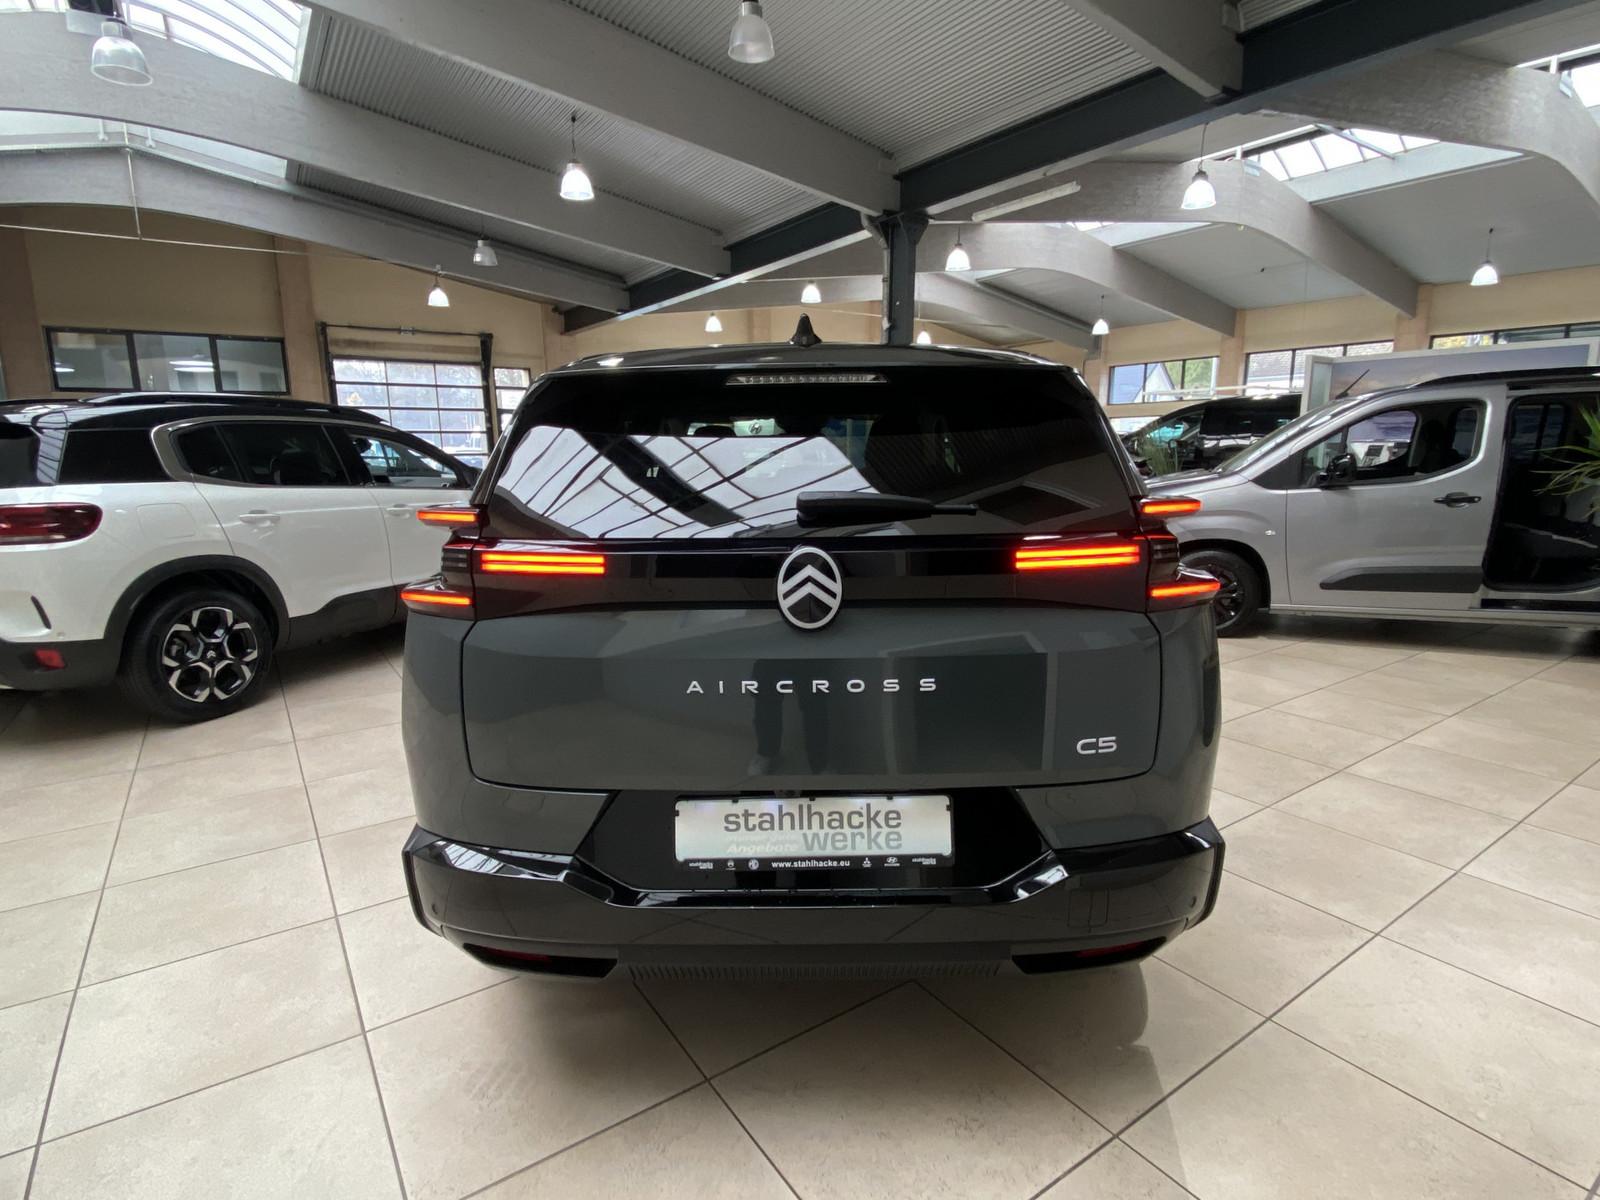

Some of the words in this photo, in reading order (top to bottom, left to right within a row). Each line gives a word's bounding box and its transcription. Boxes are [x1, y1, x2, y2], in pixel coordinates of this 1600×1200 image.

[686, 677, 937, 695] AIRCROSS
[1076, 735, 1118, 755] C5
[724, 803, 902, 832] stahlhacke
[802, 829, 902, 852] werke
[771, 859, 851, 868] www.stahlhacke.eu
